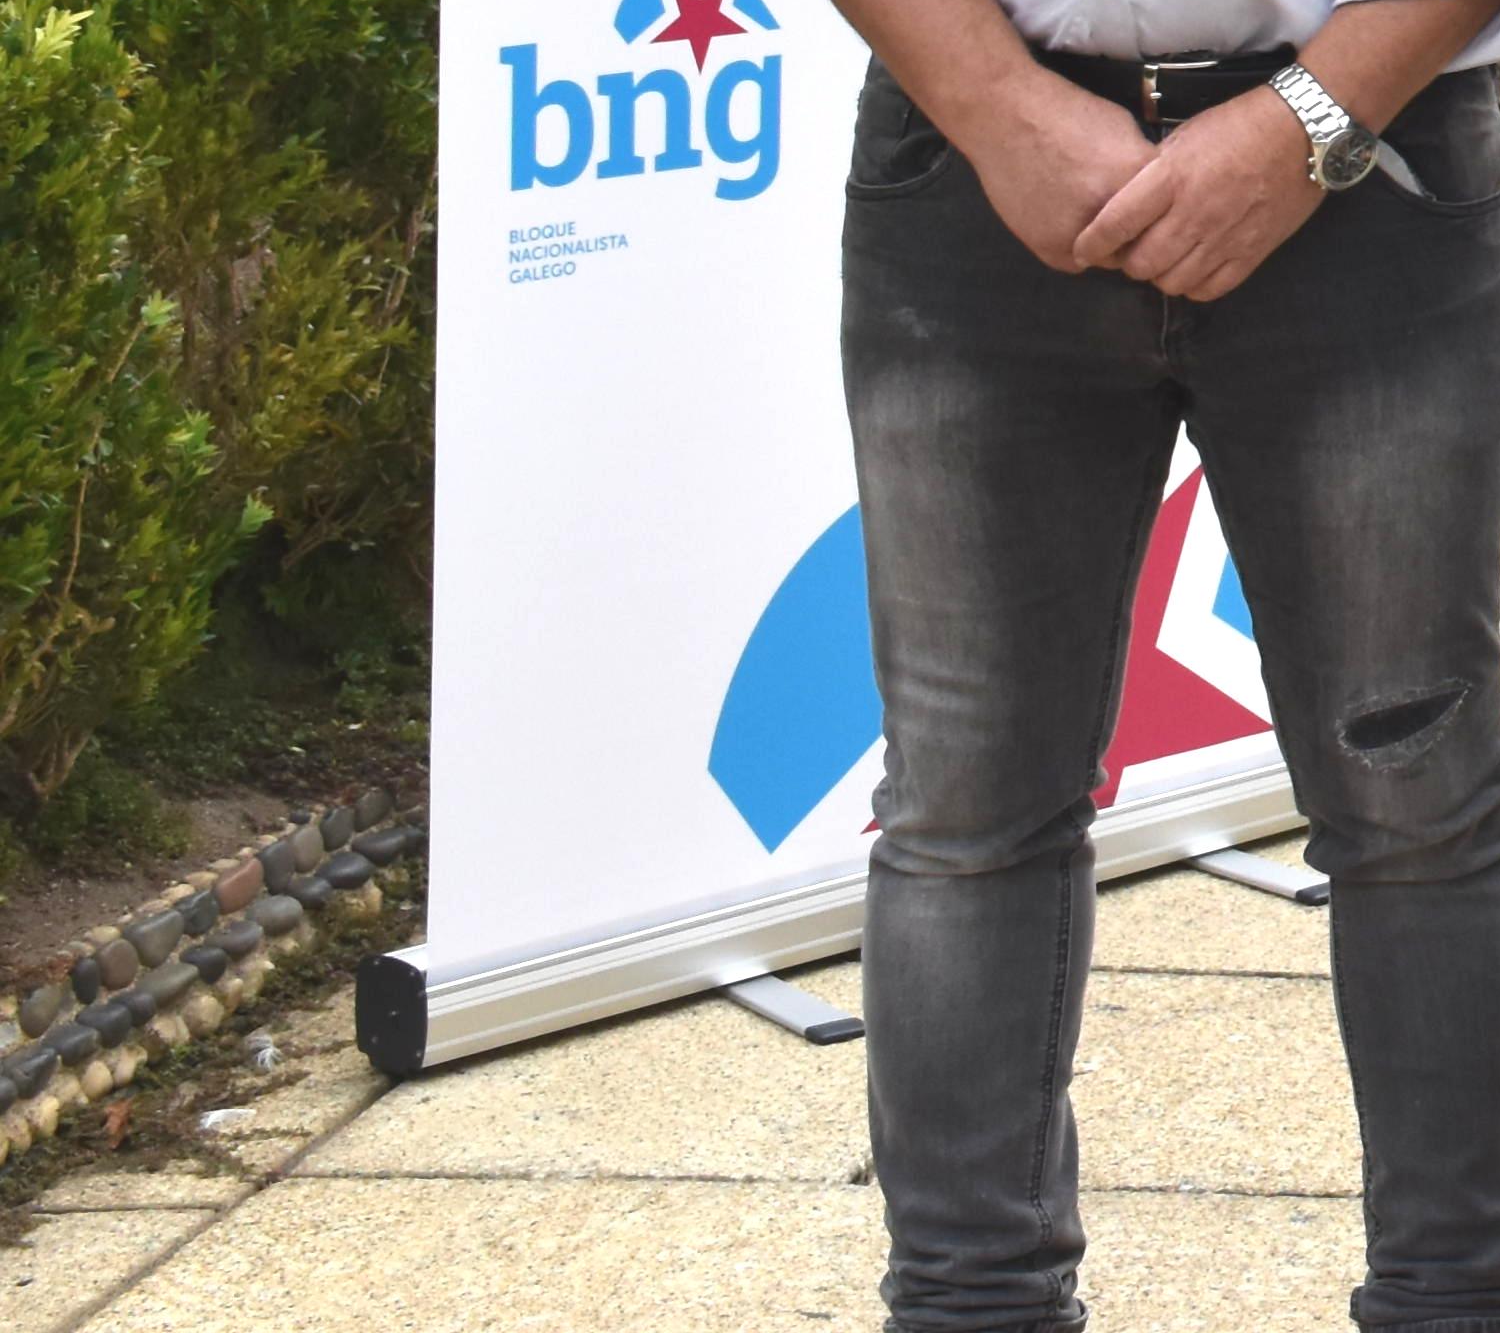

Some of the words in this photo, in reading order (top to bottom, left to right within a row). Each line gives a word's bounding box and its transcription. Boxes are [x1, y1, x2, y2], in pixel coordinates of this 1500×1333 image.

[498, 43, 783, 202] bng
[509, 221, 577, 244] BLOQUE
[509, 234, 629, 264] NACIONALISTA
[510, 261, 577, 284] GALEGO
